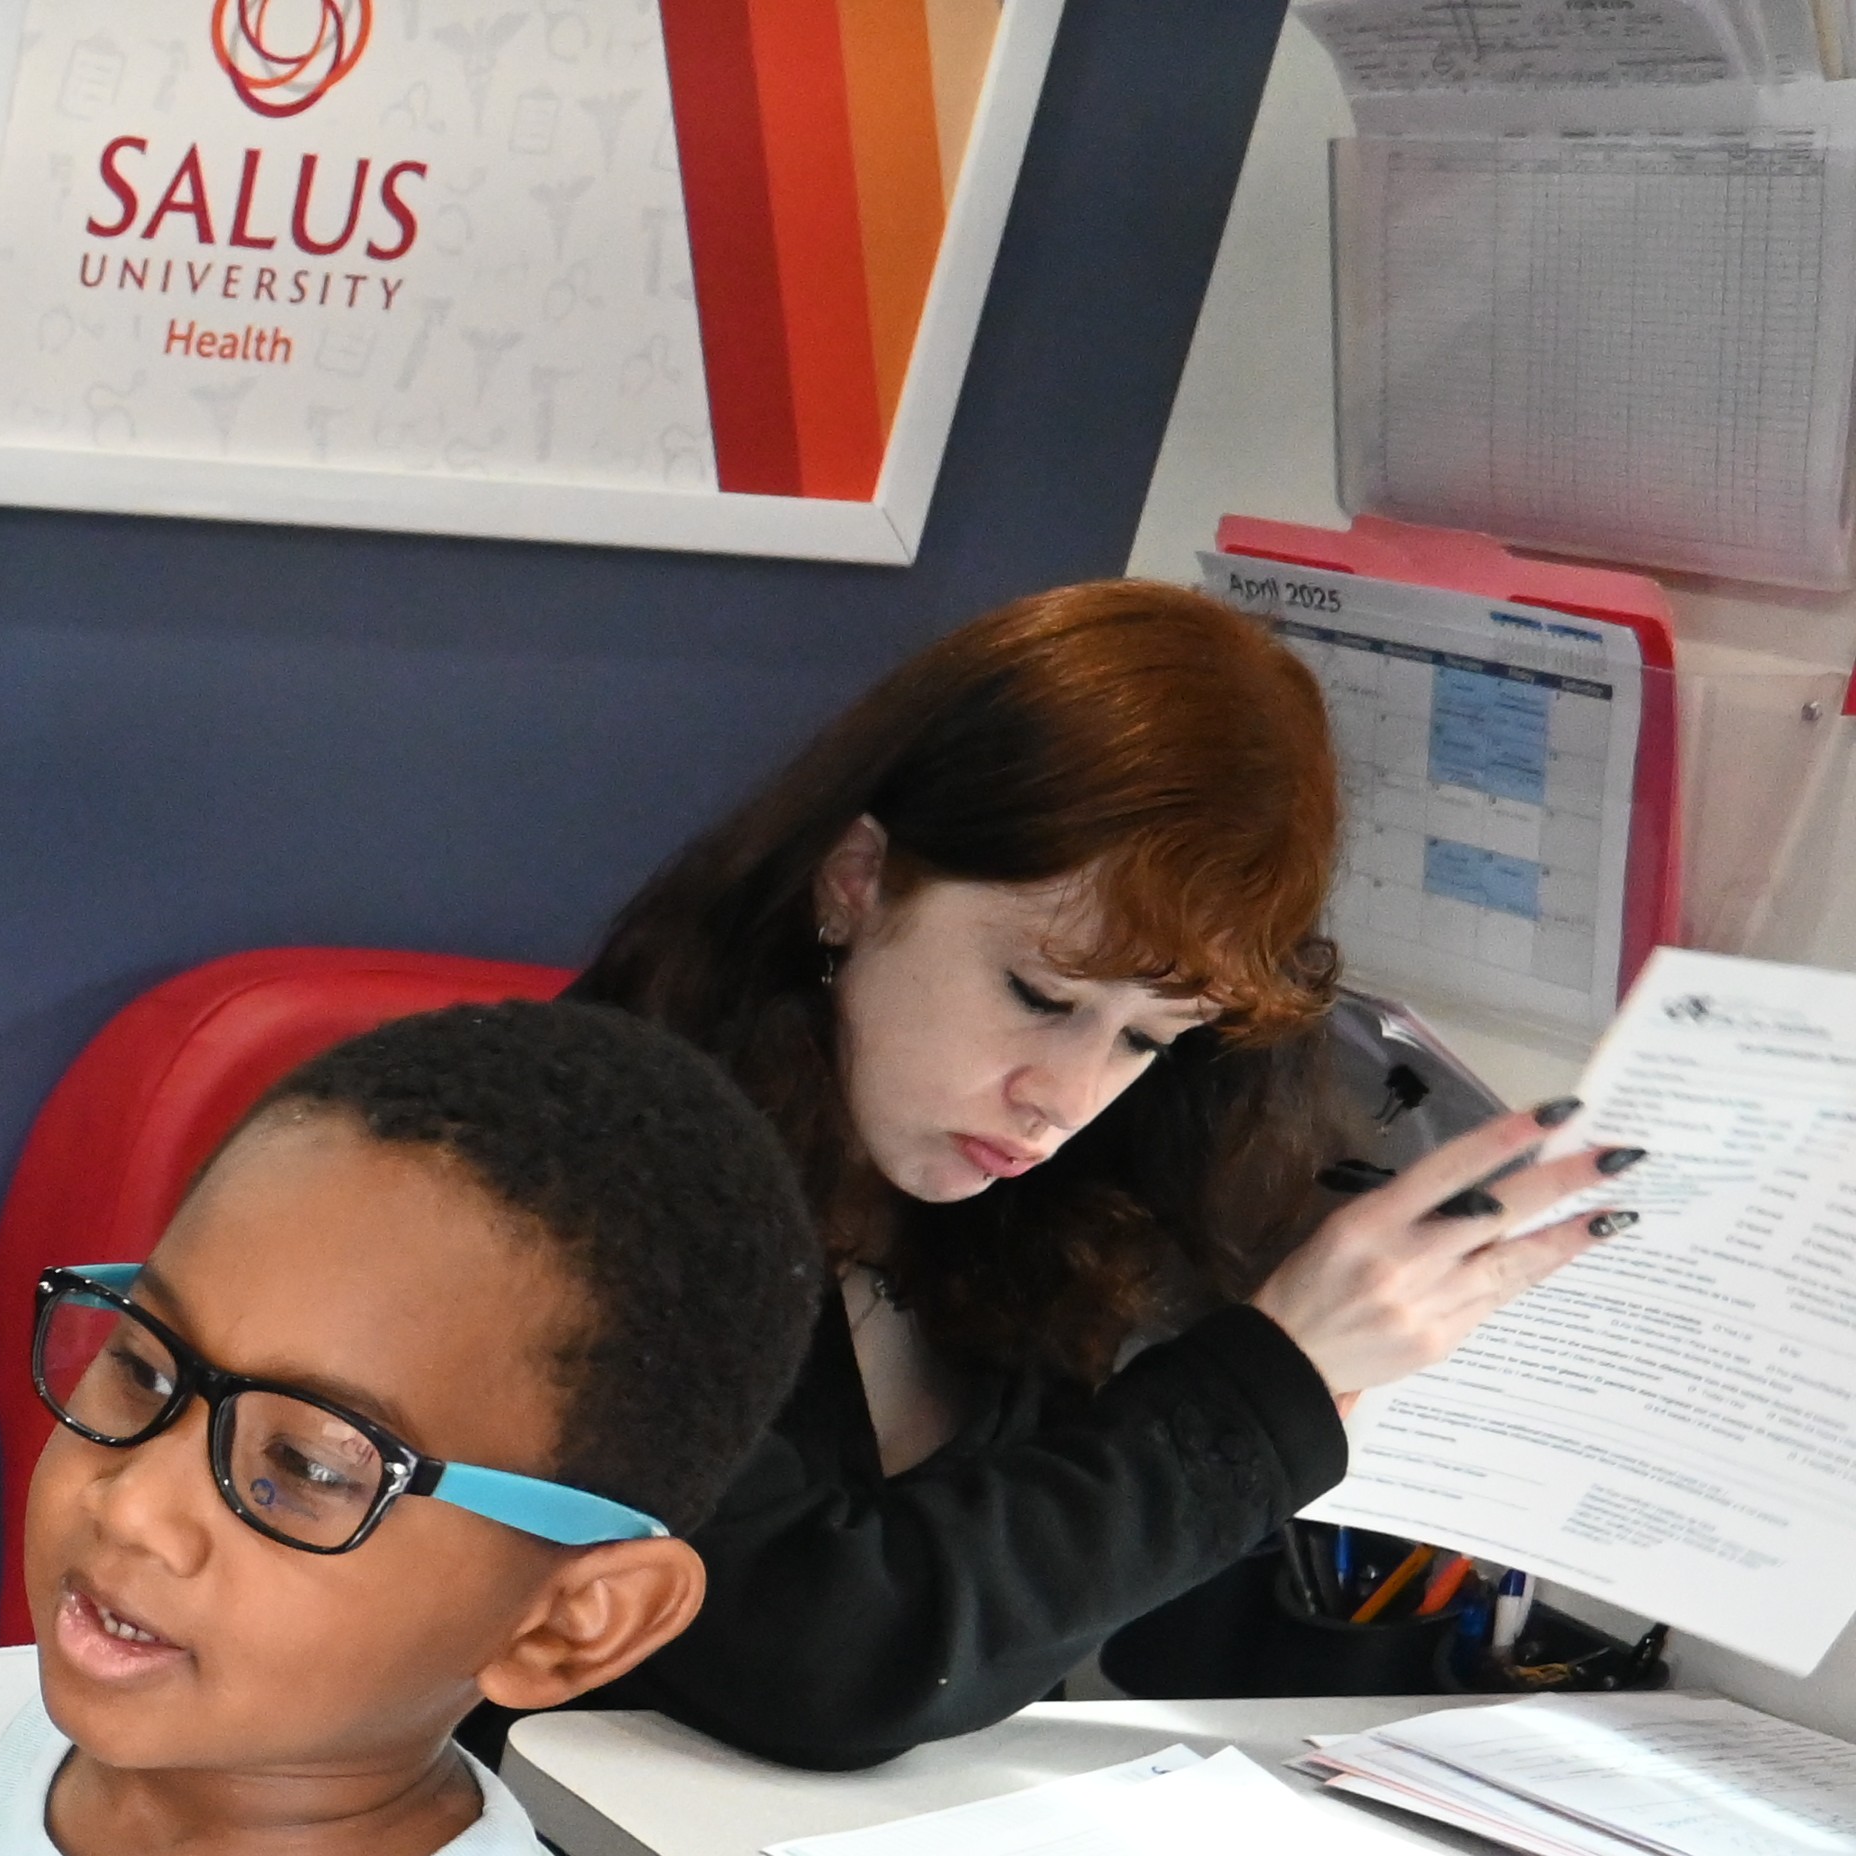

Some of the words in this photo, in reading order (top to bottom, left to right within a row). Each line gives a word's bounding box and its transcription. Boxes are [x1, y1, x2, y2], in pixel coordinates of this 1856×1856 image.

[85, 134, 429, 262] SALUS
[79, 252, 404, 311] UNIVERSITY
[163, 318, 295, 364] Health
[1230, 573, 1279, 602] April
[1285, 582, 1342, 613] 2025
